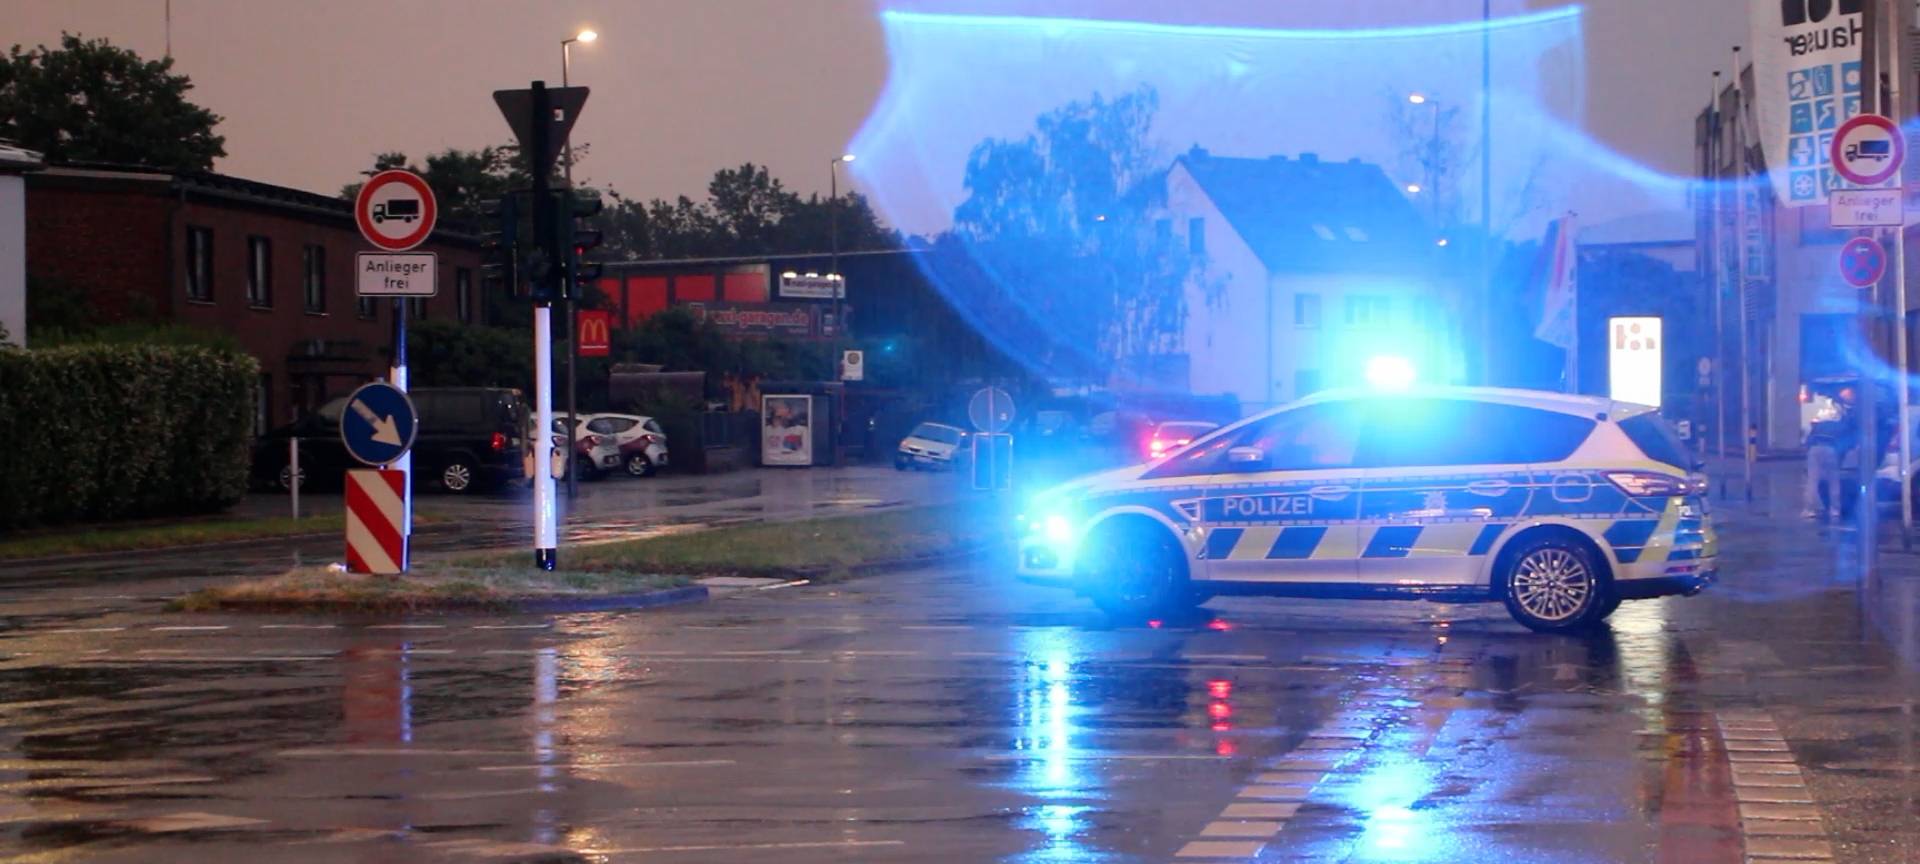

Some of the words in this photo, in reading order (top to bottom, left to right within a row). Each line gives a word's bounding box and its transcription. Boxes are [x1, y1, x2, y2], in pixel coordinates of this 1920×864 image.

[366, 260, 427, 276] Anlieger
[384, 276, 409, 288] frei
[1224, 496, 1313, 516] POLIZEI
